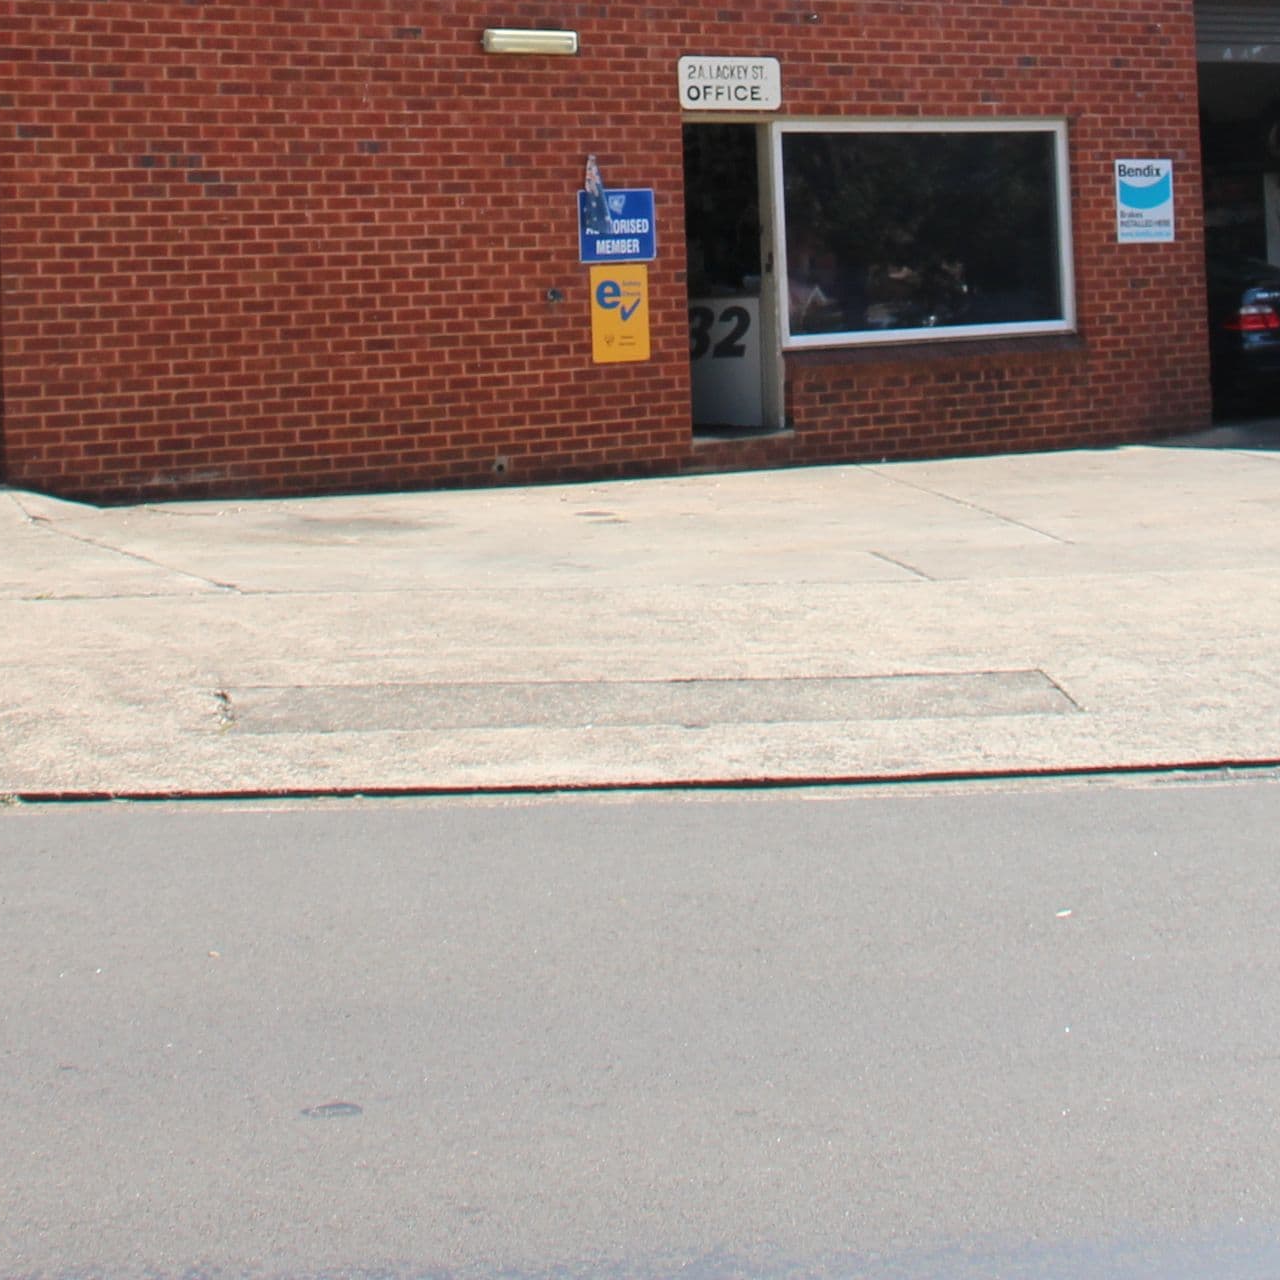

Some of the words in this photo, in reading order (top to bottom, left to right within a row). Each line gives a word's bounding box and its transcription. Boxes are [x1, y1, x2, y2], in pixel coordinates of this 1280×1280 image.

[709, 65, 749, 80] LACKEY
[1118, 164, 1161, 177] Bendix
[586, 218, 650, 235] ORISED
[596, 239, 640, 255] MEMBER
